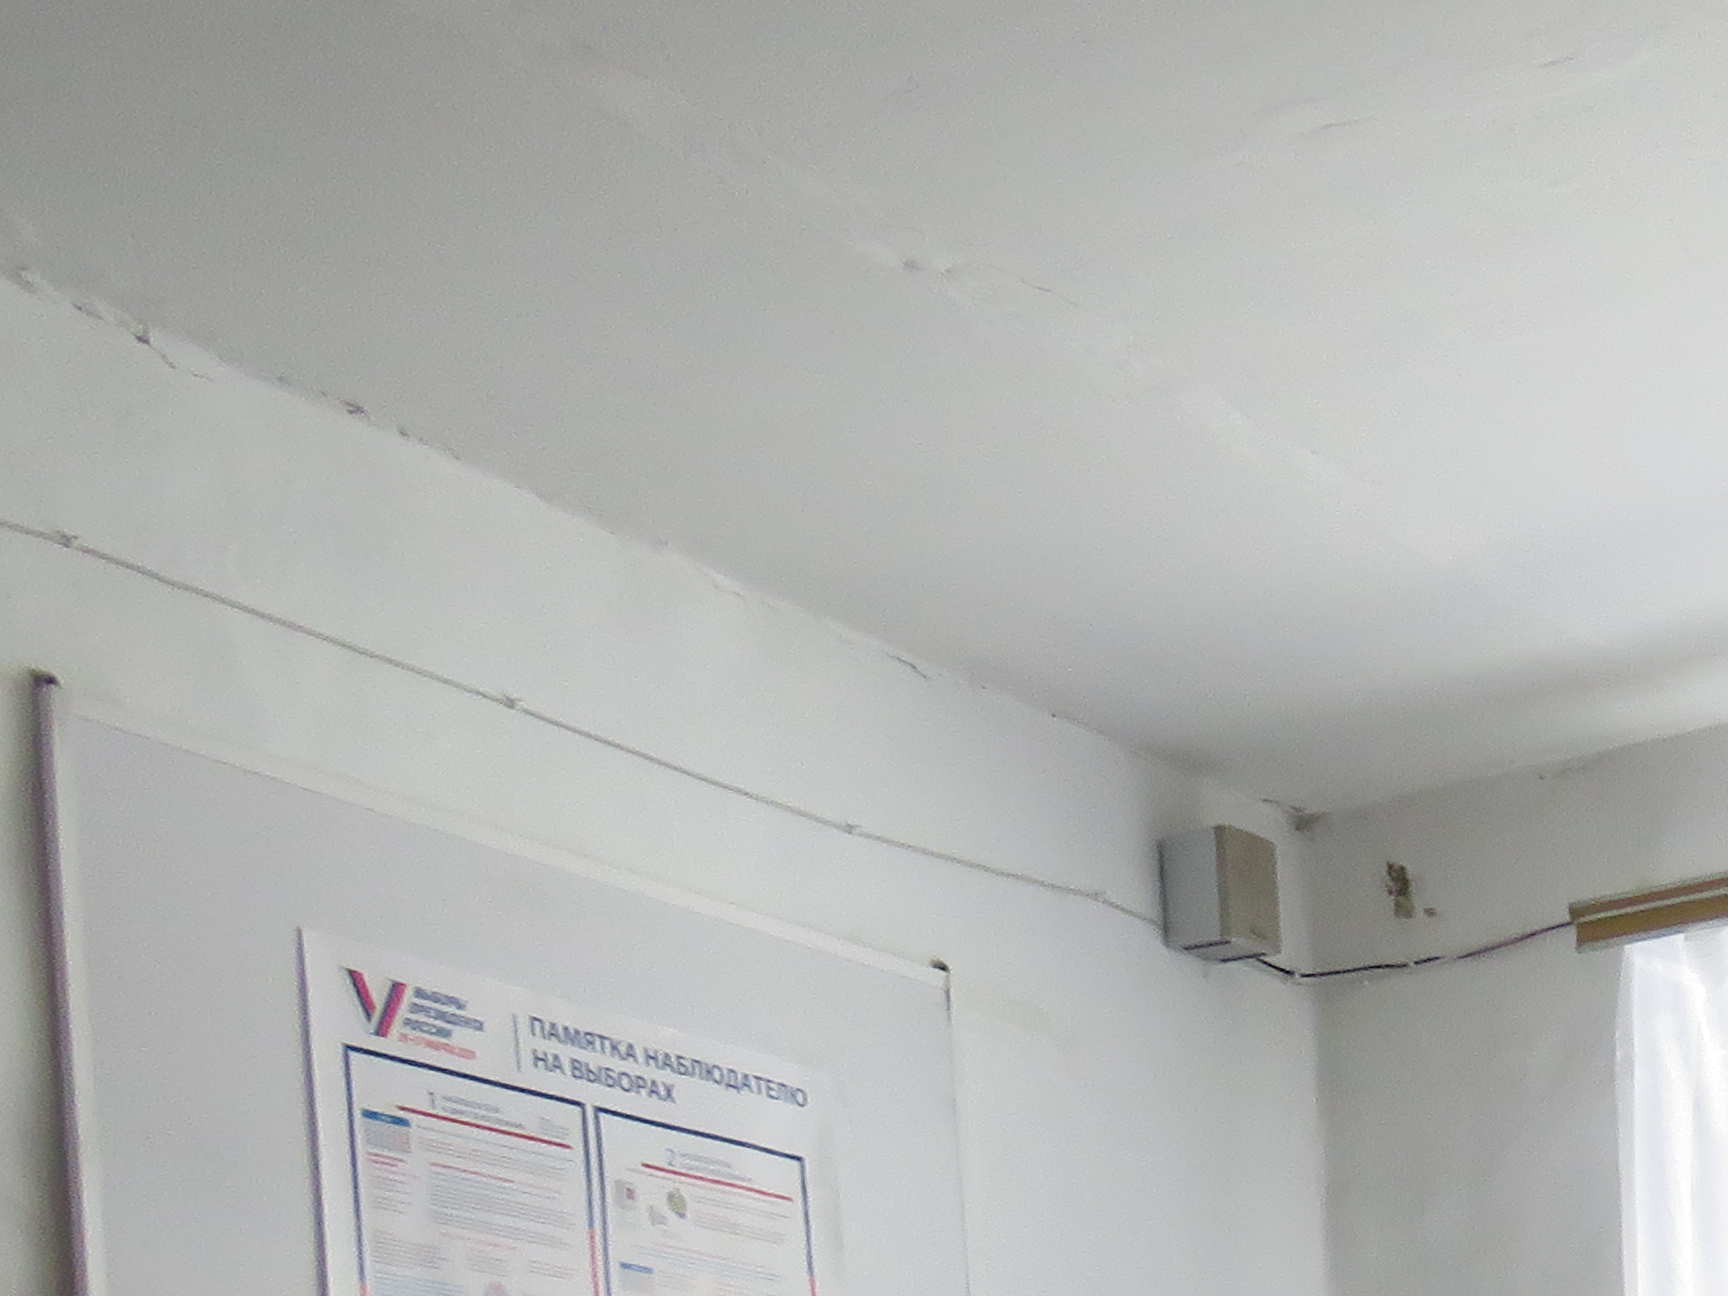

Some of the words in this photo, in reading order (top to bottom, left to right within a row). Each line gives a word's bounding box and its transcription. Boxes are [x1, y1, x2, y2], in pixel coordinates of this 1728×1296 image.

[528, 1014, 639, 1064] ПАМЯТКА
[643, 1046, 809, 1108] НАБЛЮДАТЕЛЮ
[532, 1049, 567, 1077] НА
[570, 1057, 677, 1103] ВЫБОРАХ
